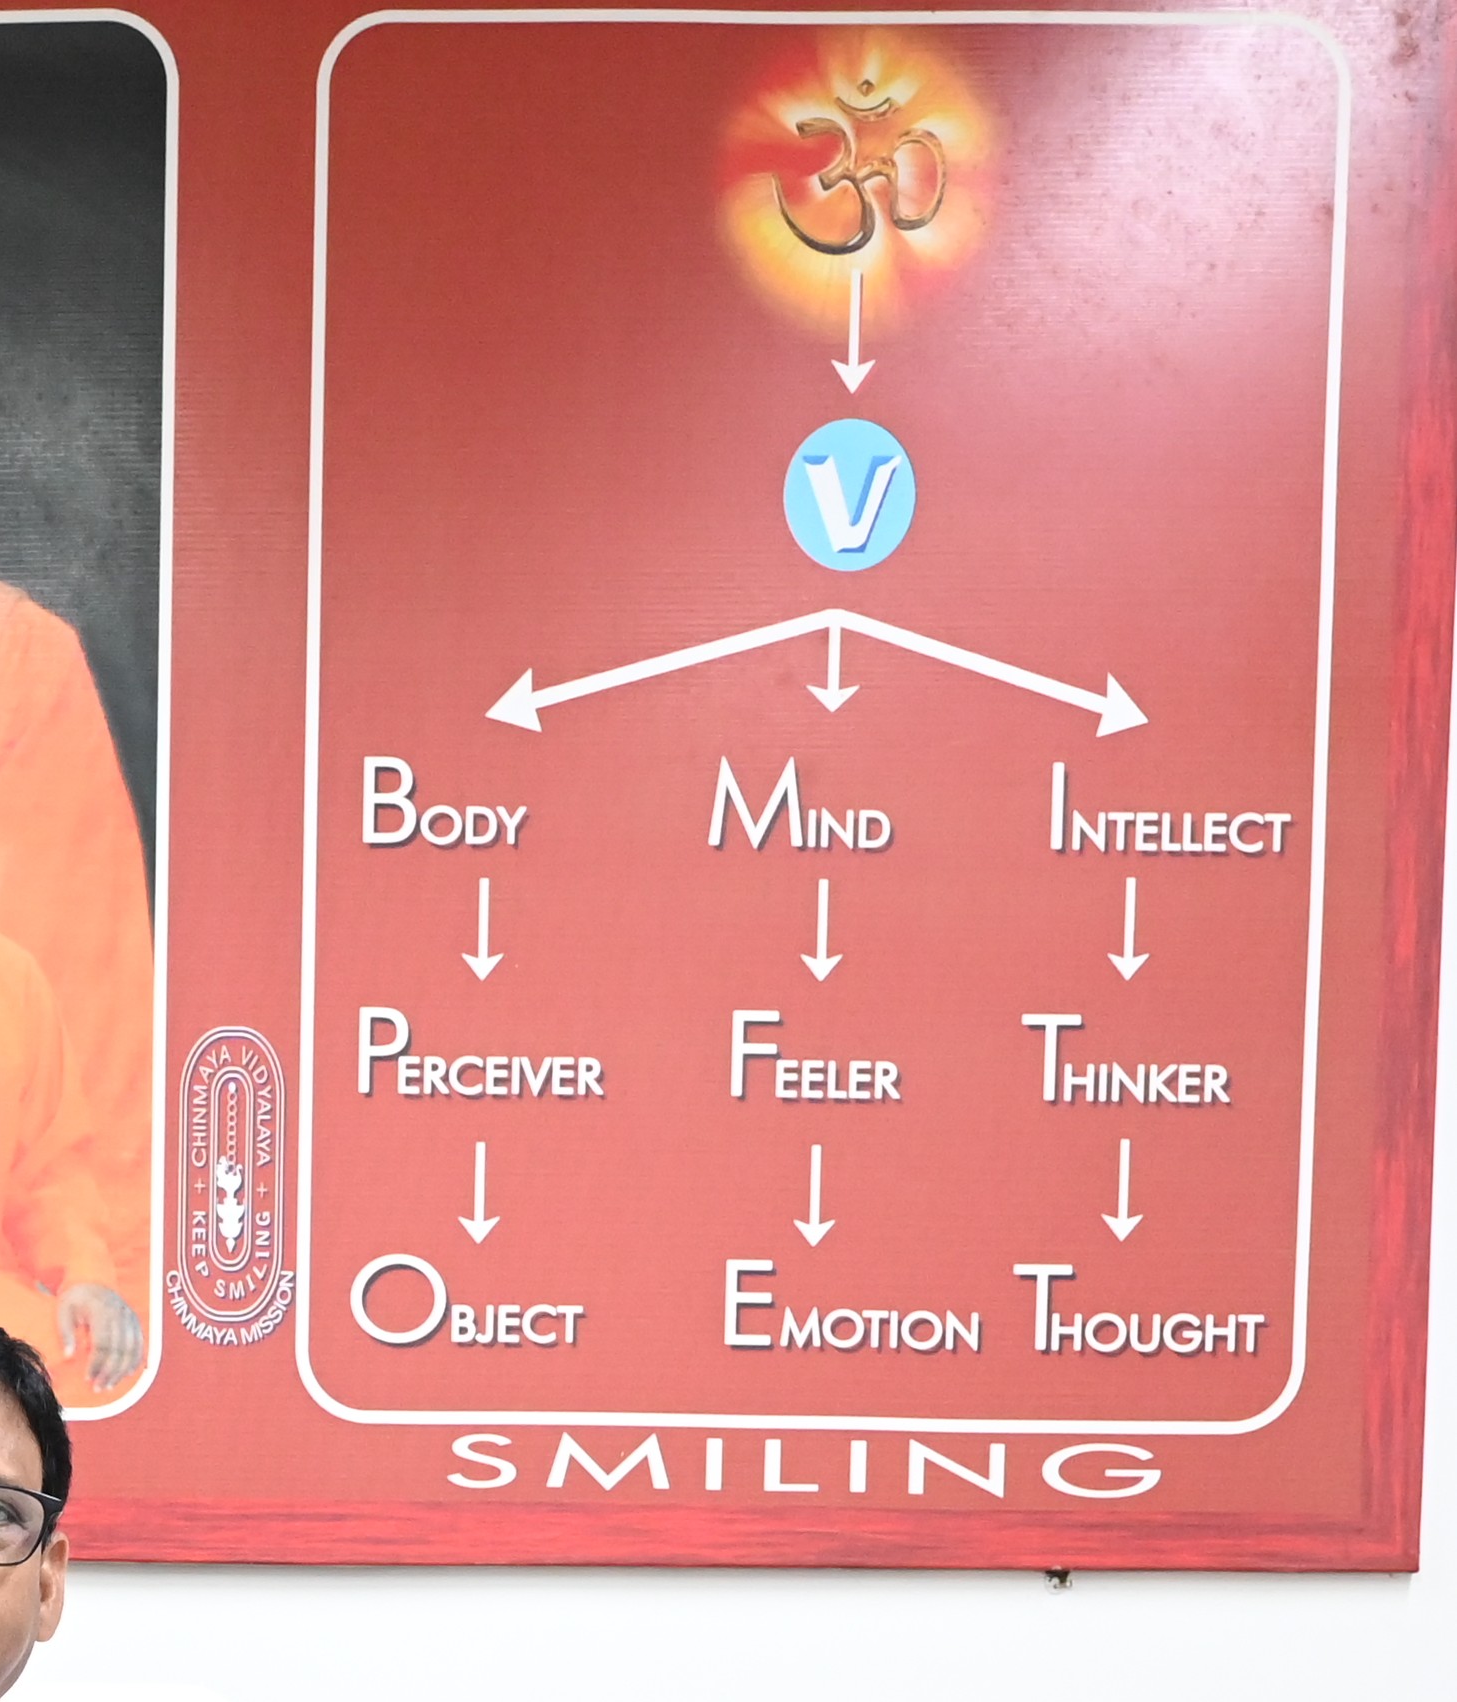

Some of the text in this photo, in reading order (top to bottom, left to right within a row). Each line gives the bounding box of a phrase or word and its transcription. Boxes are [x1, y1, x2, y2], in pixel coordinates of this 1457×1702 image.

[803, 454, 902, 554] V
[190, 1043, 274, 1168] CHINMAYA VIDYALAYA
[191, 1210, 272, 1301] KEEP SMILING
[165, 1269, 296, 1347] CHINMAYA MISSION
[447, 1432, 1162, 1499] SMILING
